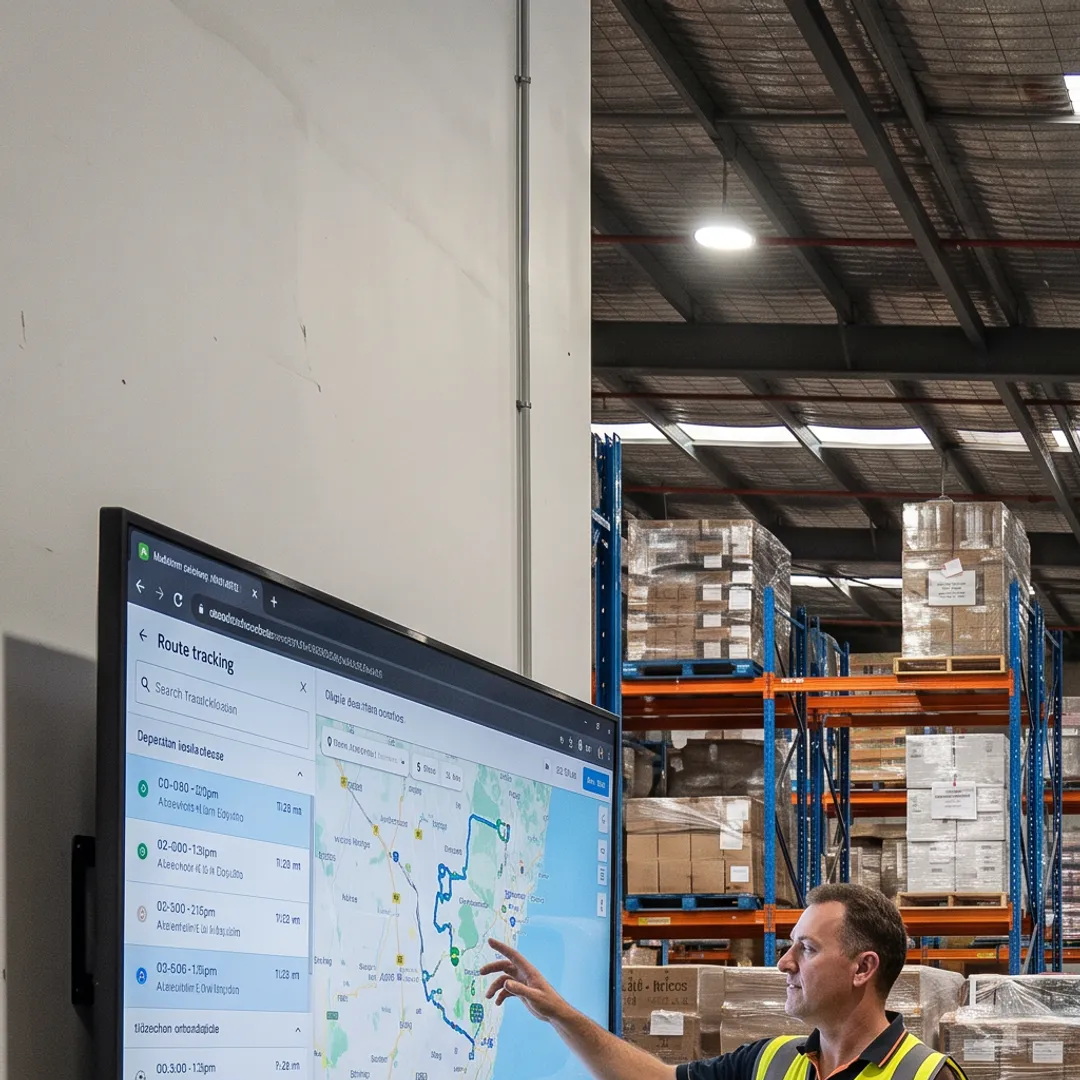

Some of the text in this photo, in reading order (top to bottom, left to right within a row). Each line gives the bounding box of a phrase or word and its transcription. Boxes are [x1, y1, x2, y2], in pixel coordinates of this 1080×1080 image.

[158, 633, 234, 675] Route tracking
[155, 682, 182, 700] Search
